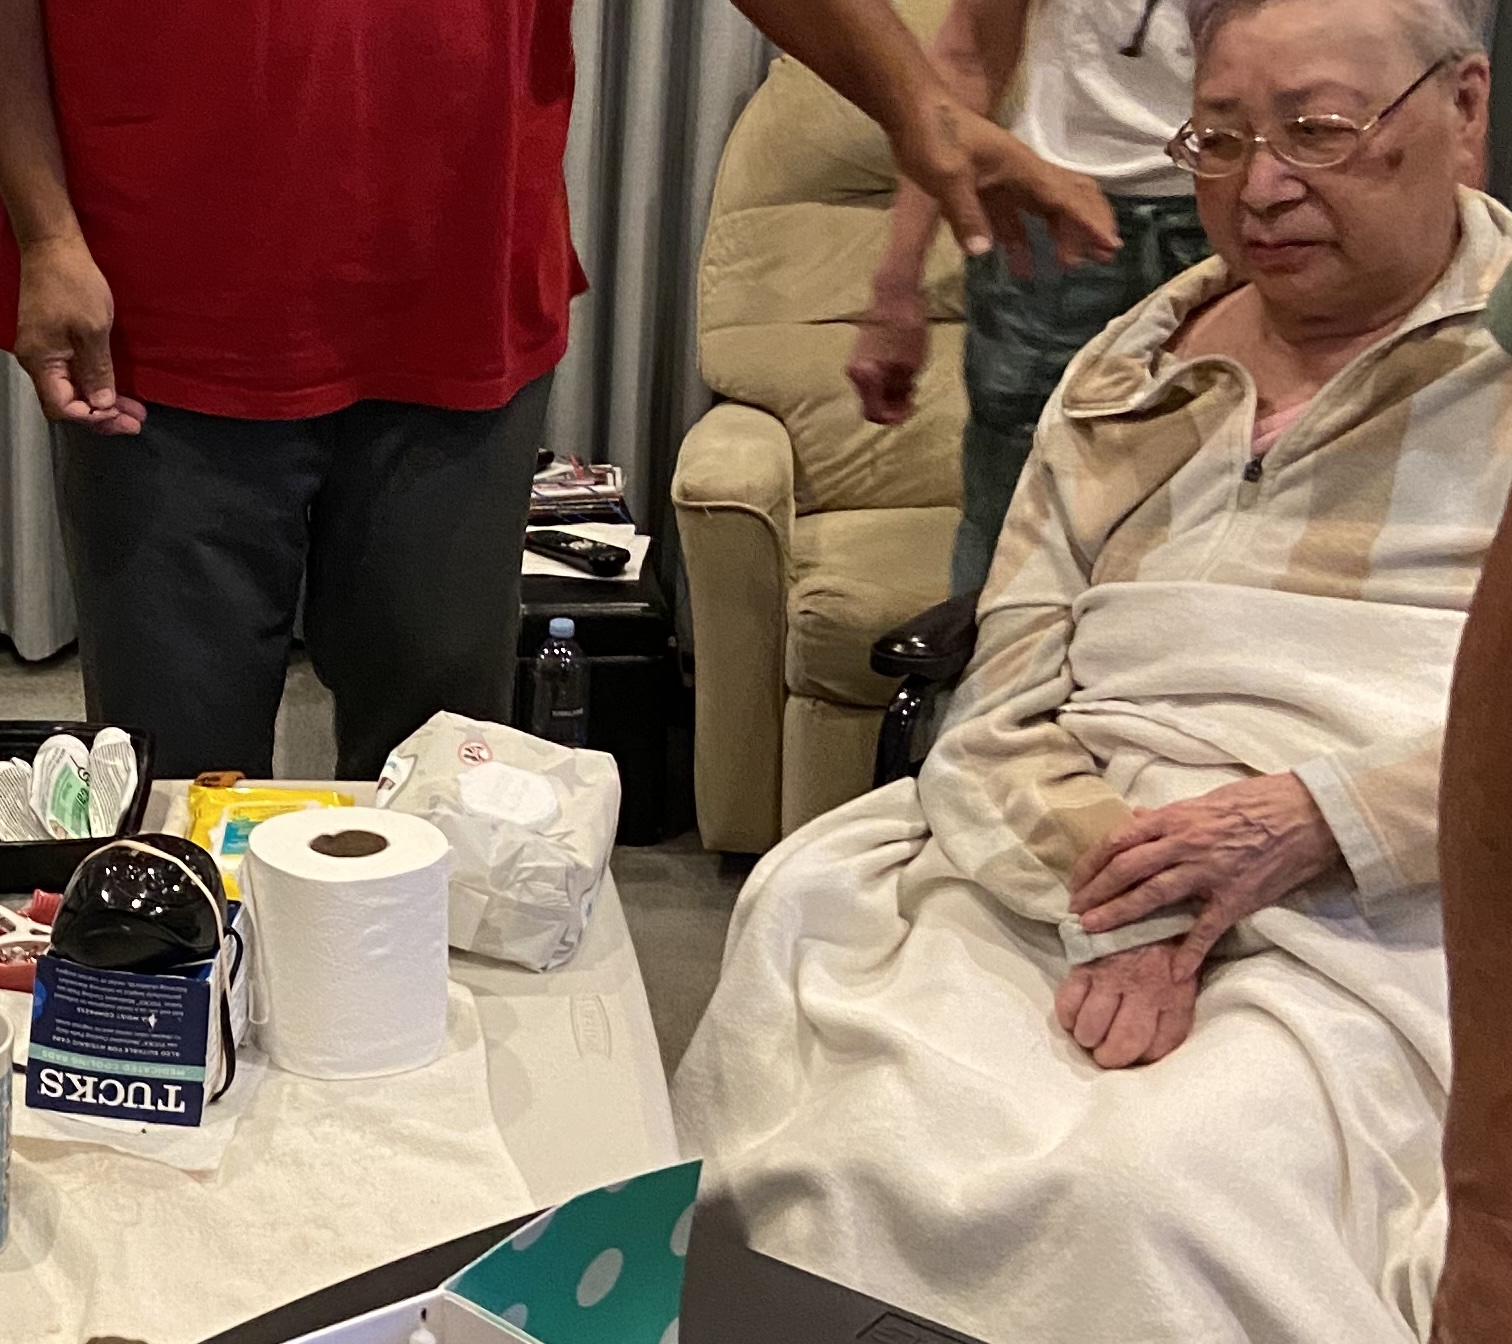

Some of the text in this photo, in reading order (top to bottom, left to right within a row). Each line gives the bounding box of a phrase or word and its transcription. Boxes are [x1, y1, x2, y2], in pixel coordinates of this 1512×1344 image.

[41, 1049, 186, 1076] MEDICATED COOLING PADS
[39, 1068, 186, 1114] TUCKS
